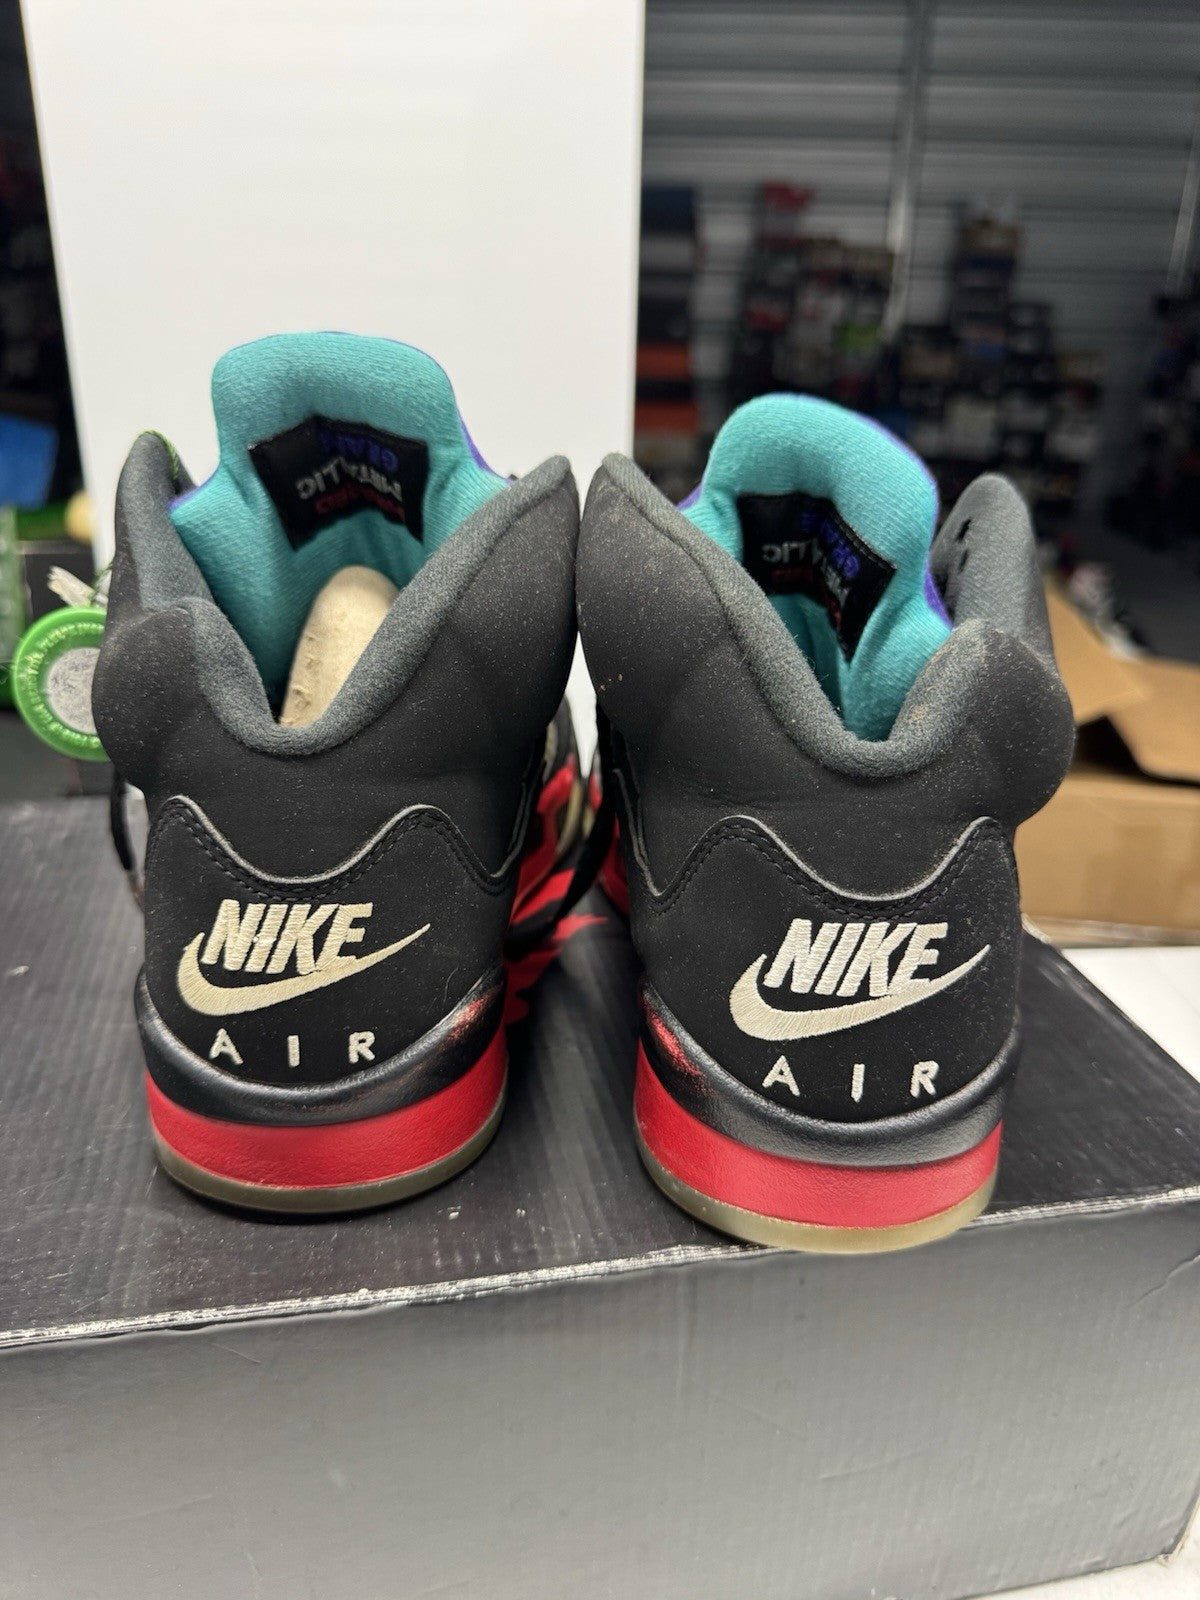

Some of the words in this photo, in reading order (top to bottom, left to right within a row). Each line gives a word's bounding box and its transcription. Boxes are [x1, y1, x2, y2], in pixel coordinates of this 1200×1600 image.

[201, 899, 373, 975] NIKE
[763, 918, 948, 997] NIKE
[209, 1028, 375, 1068] AIR
[762, 1055, 939, 1102] AIR
